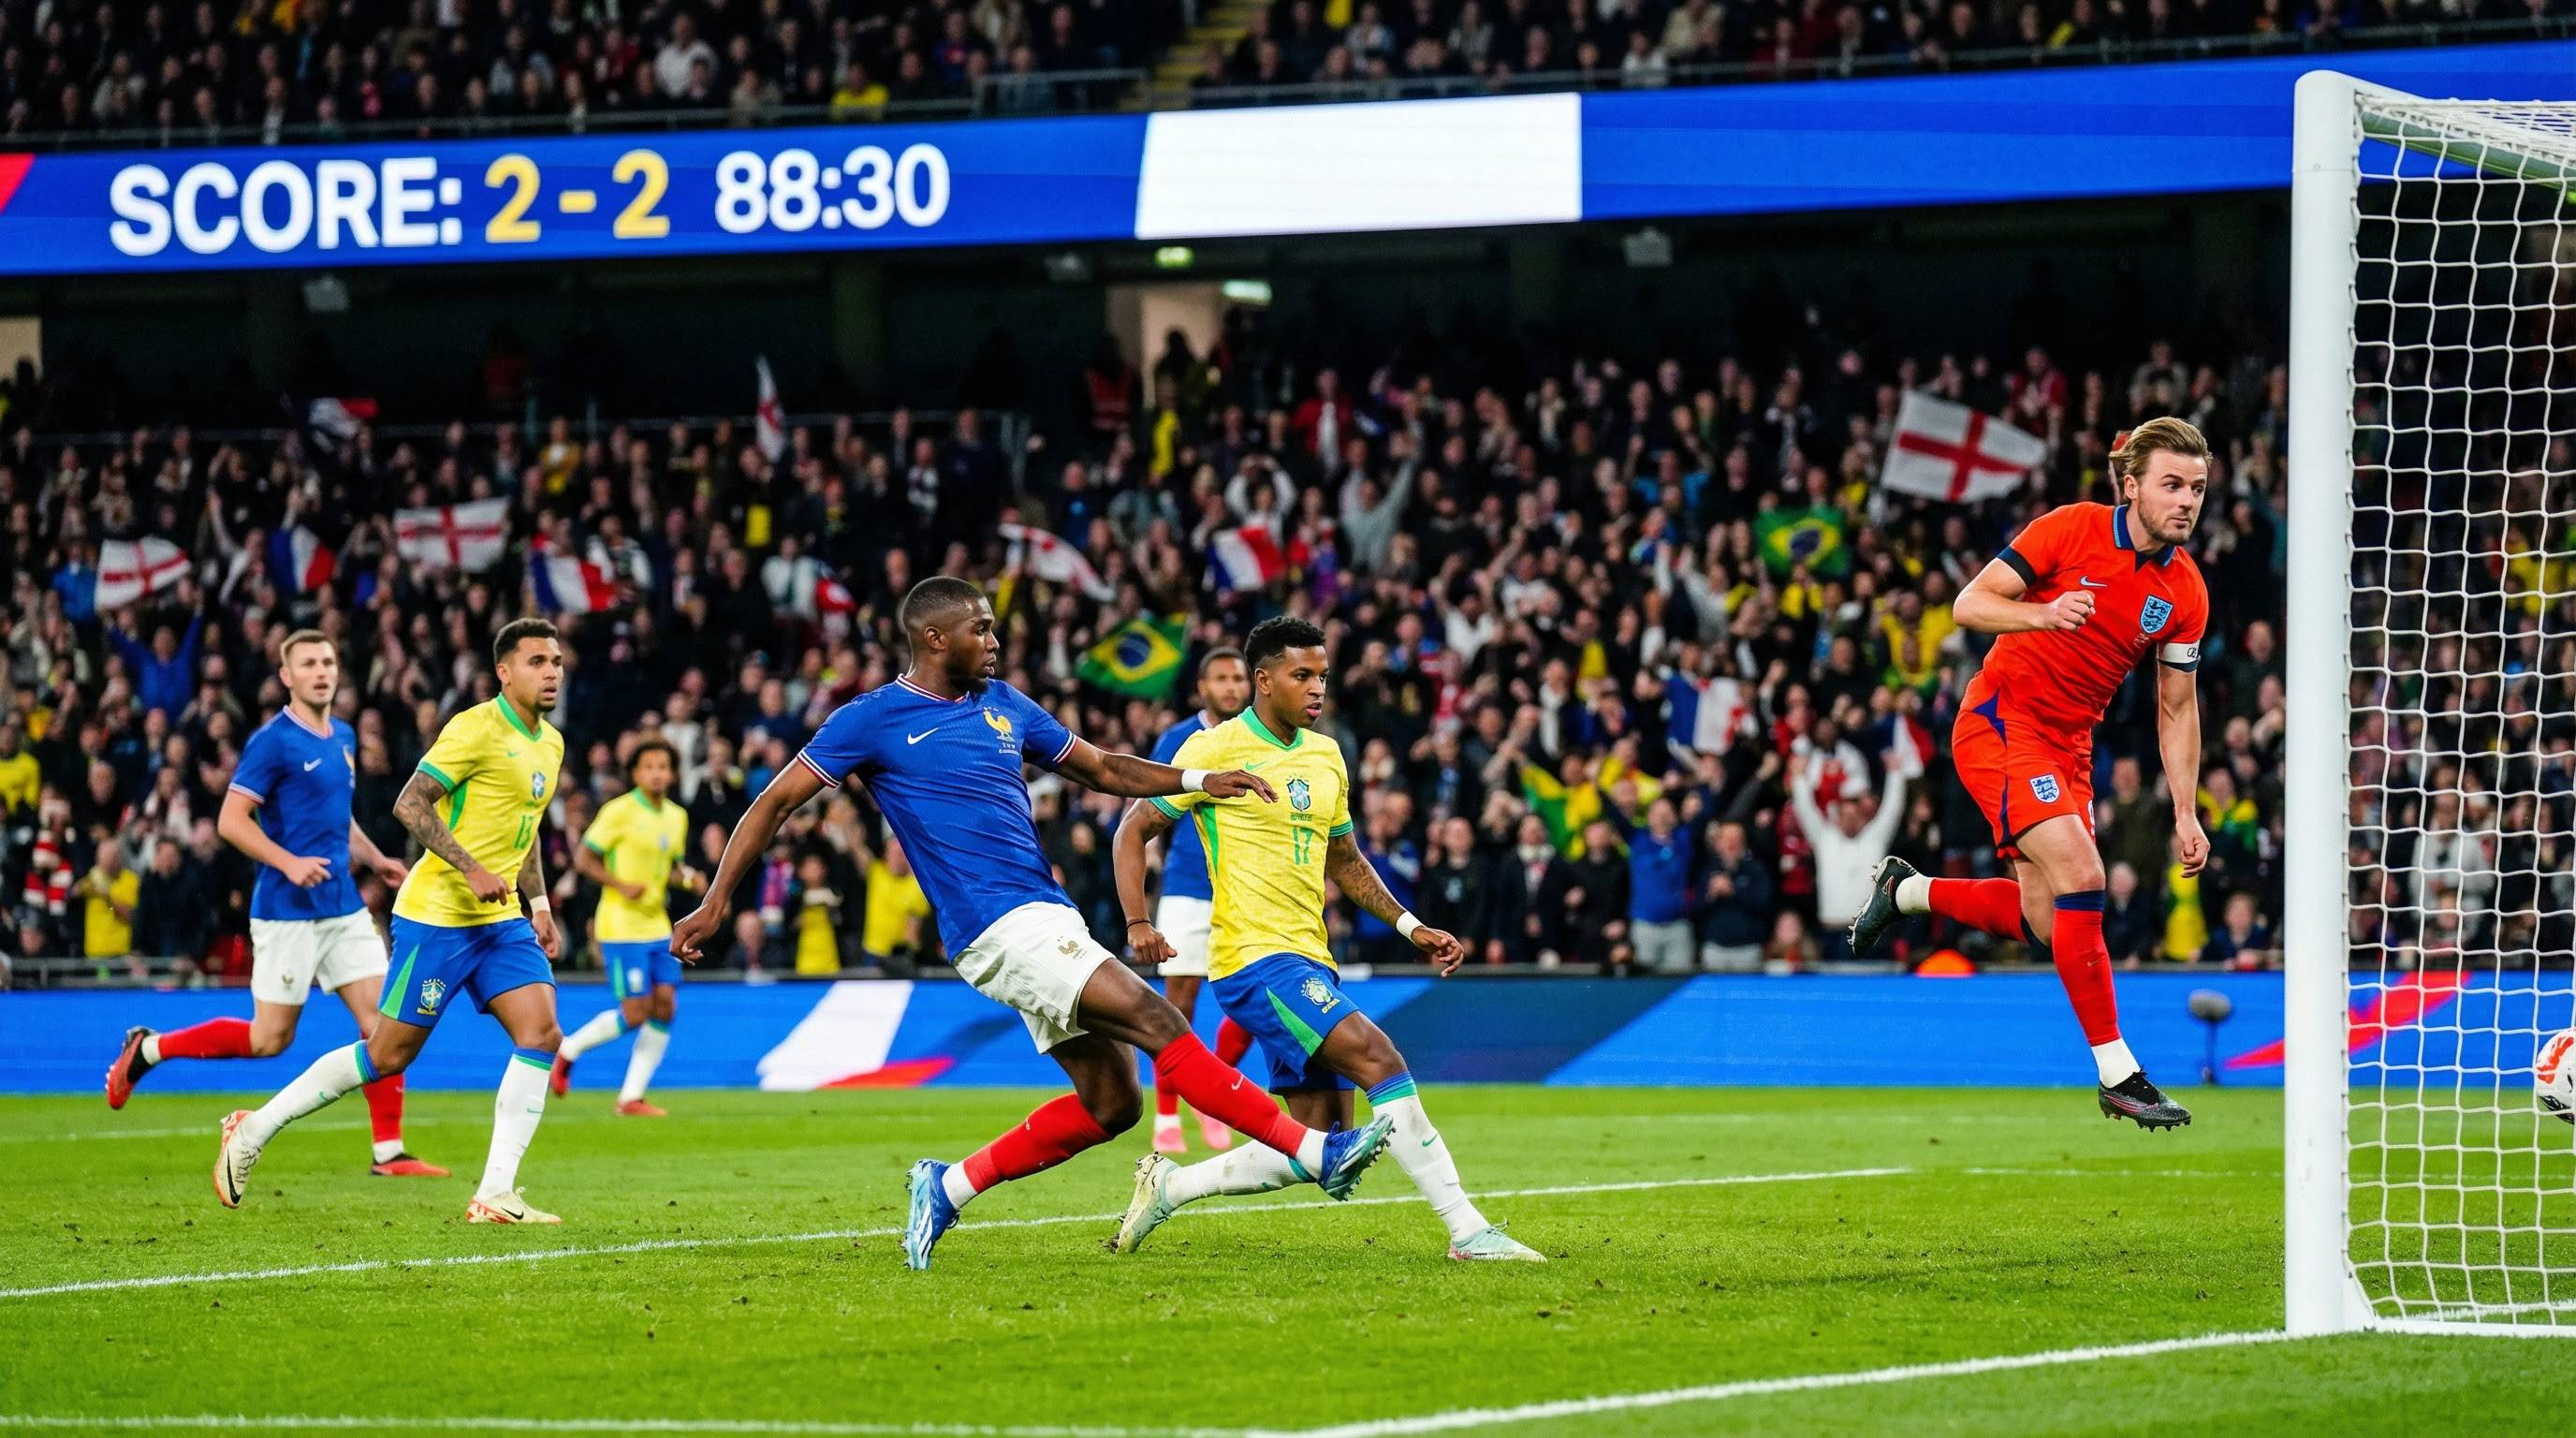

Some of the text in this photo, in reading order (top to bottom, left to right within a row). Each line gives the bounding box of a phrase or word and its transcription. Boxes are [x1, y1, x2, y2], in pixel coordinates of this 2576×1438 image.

[110, 143, 950, 257] SCORE: 2 - 2 88:30
[514, 814, 534, 849] 13
[1293, 825, 1314, 865] 17
